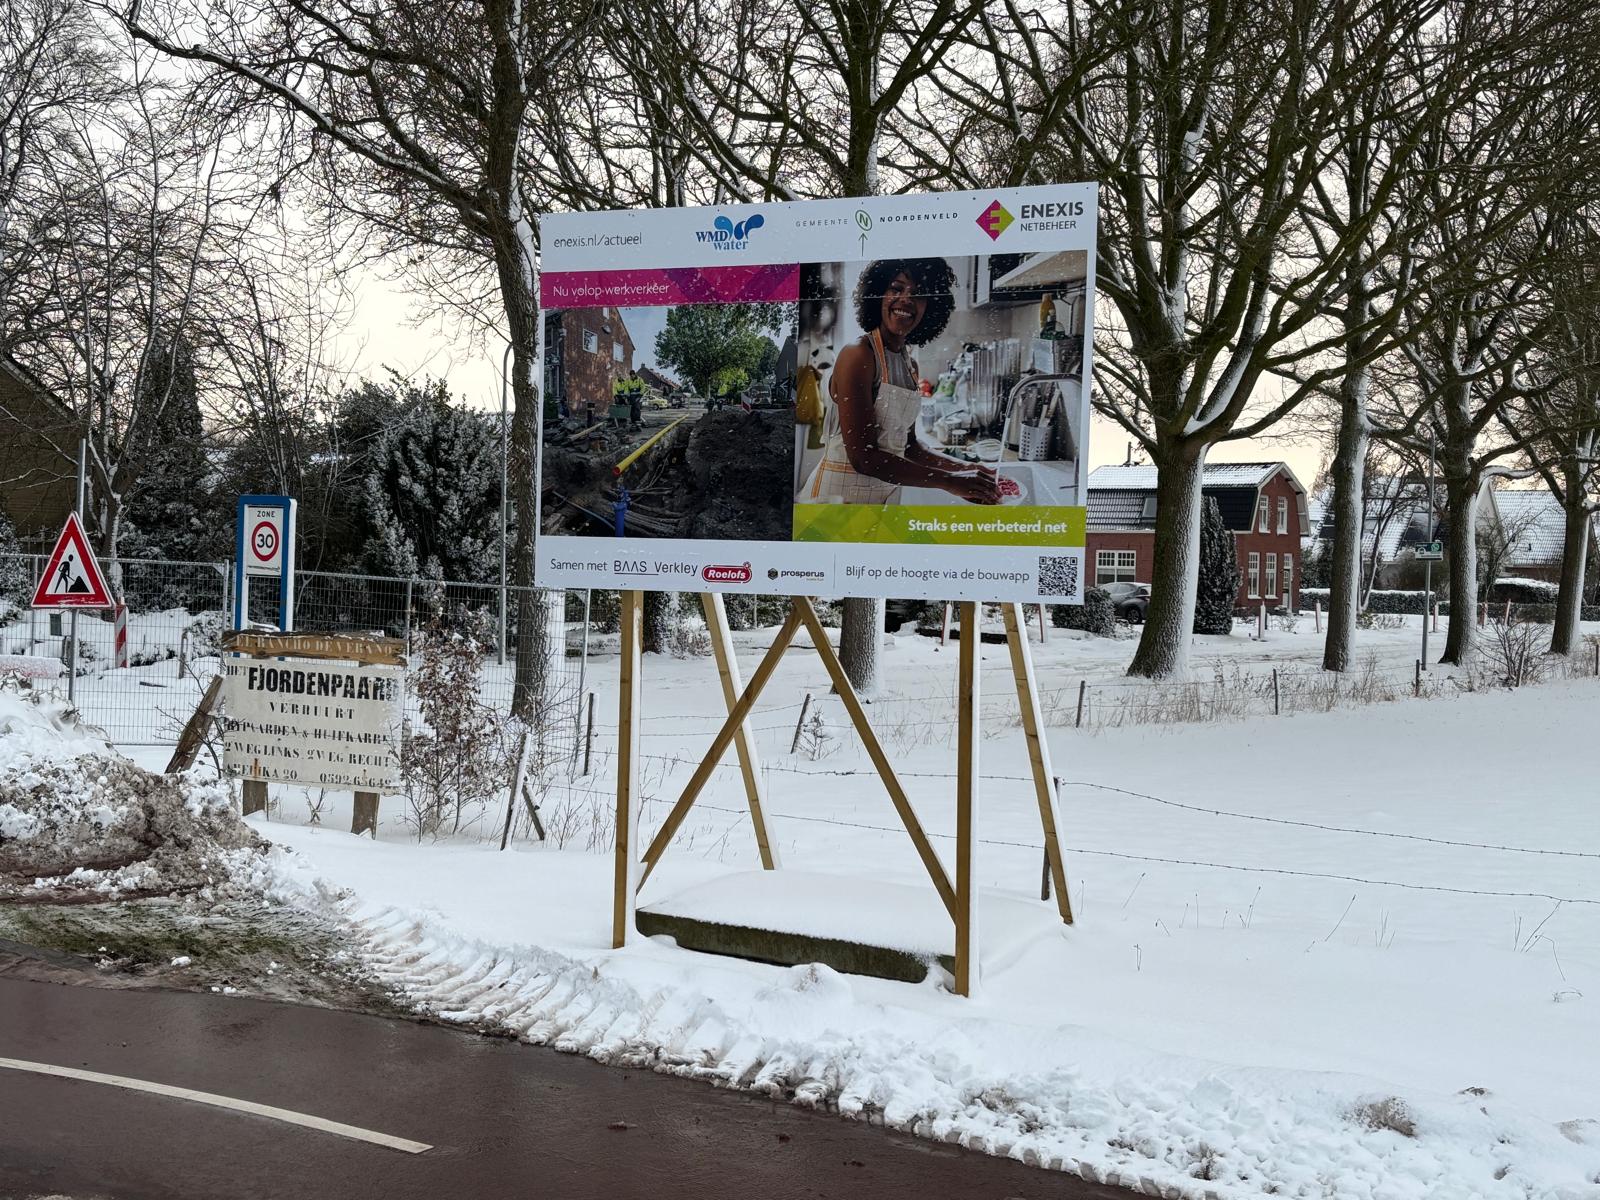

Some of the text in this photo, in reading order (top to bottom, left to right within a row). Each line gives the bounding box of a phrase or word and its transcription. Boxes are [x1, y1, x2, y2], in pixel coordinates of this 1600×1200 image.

[1020, 201, 1084, 219] ENEXIS
[795, 218, 848, 228] GEMEENTE
[879, 212, 959, 223] NOORDENVELD
[1020, 220, 1077, 232] NETBEHEER
[553, 232, 642, 248] enexis.nl/actueel
[695, 230, 729, 243] WMD
[713, 240, 749, 250] water
[553, 282, 670, 300] Nu volop werkverkeer
[256, 510, 275, 518] ZONE
[908, 518, 1068, 533] Straks een verbeterd net
[256, 533, 274, 549] 30
[550, 558, 608, 571] Samen met
[654, 561, 698, 577] Verkley
[708, 569, 746, 579] Roelofs
[780, 570, 825, 578] prosperus
[846, 566, 1030, 583] Blijf op de hoogte via de bouwapp
